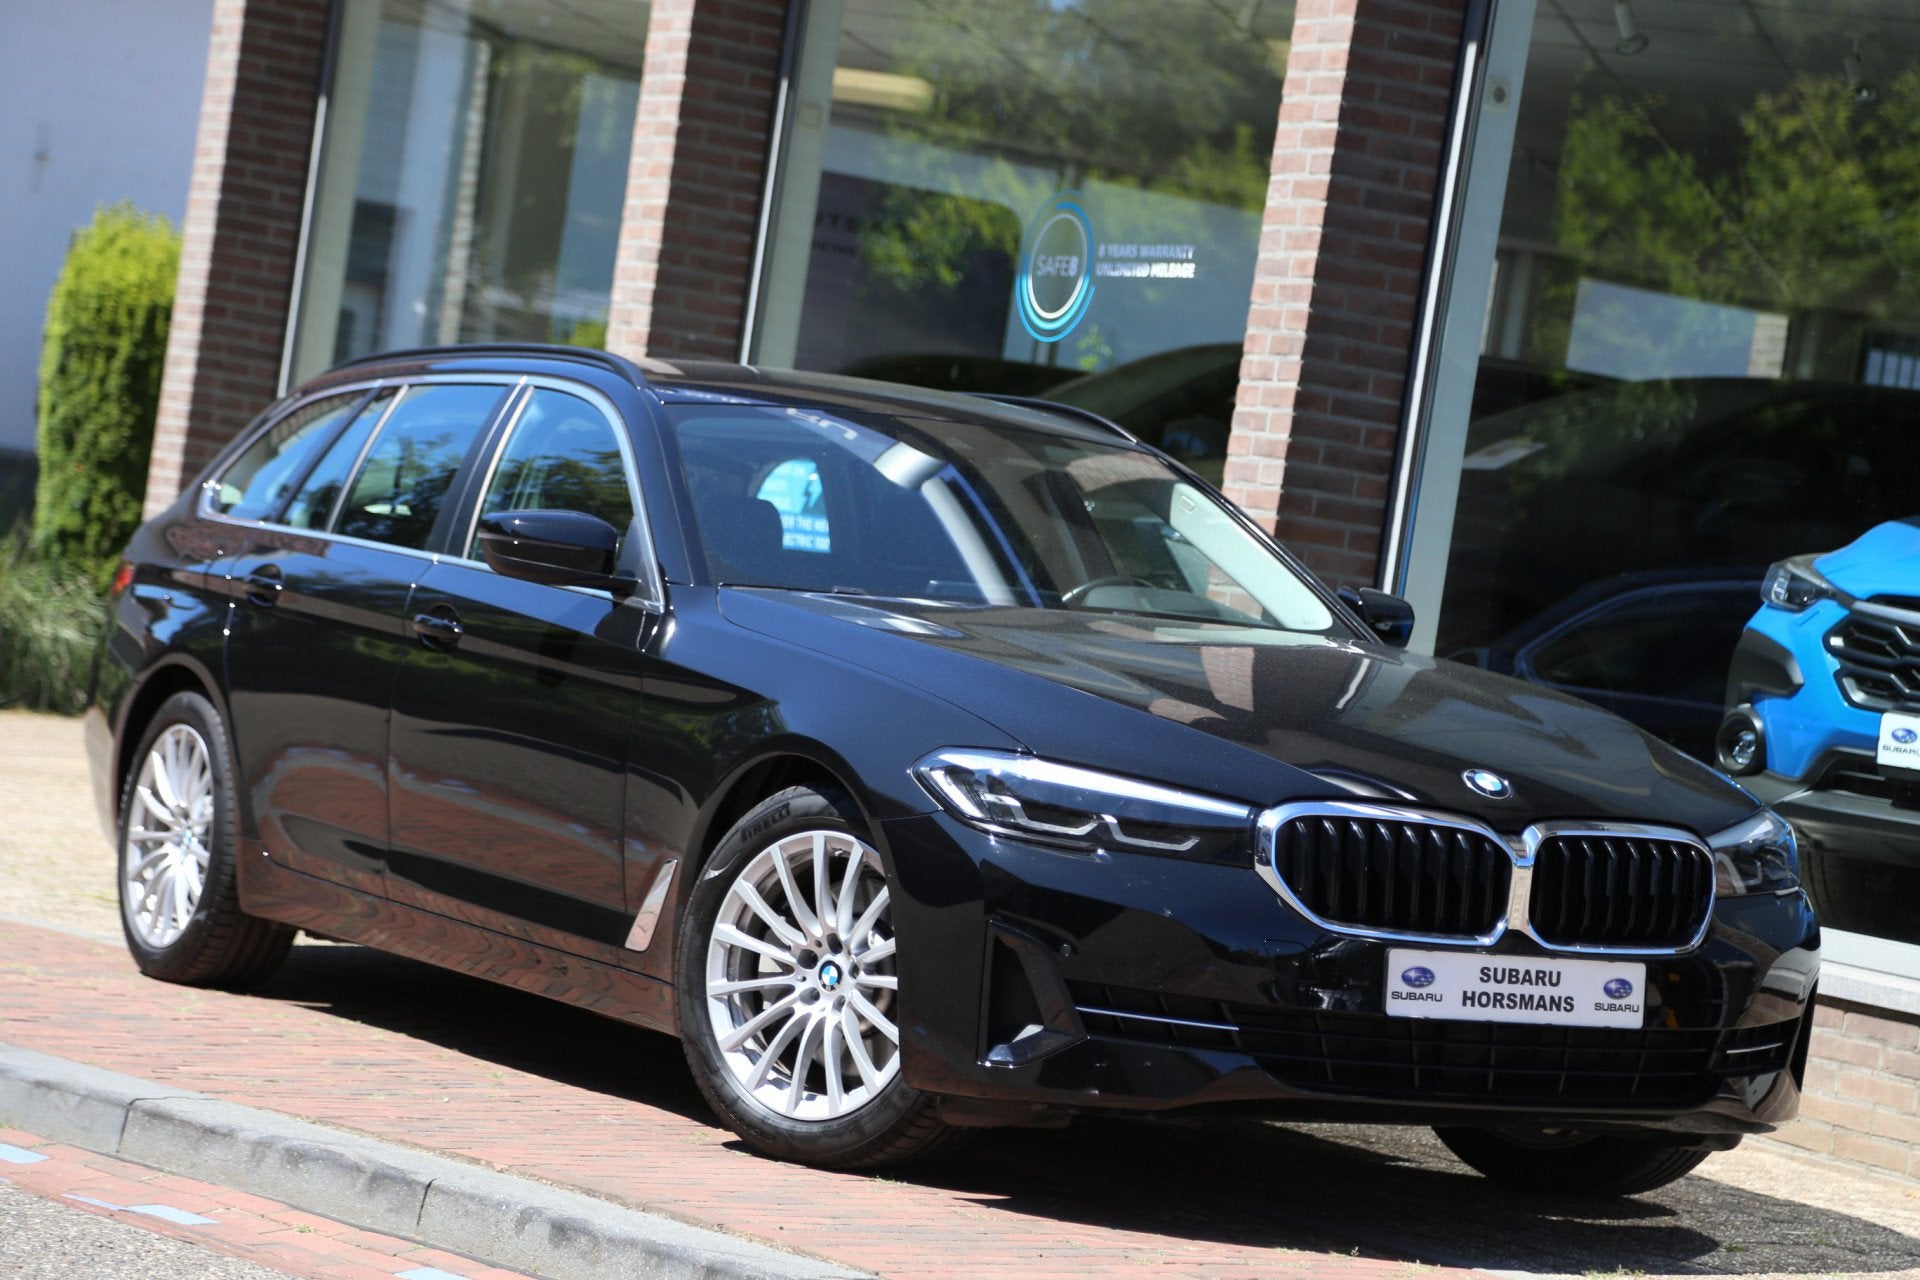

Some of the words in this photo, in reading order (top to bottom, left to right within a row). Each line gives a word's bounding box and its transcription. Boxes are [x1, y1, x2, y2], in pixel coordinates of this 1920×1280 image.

[1107, 243, 1138, 259] YEARS
[1139, 244, 1195, 260] WARRANTY
[1095, 260, 1150, 278] UNLIMITED
[1150, 262, 1196, 279] MILEAGE
[740, 802, 791, 842] PIRELLI
[1479, 966, 1562, 987] SUBARU
[1391, 991, 1443, 1003] SUBARU
[1461, 990, 1575, 1013] HORSMANS
[1594, 1002, 1640, 1013] SUBARU
